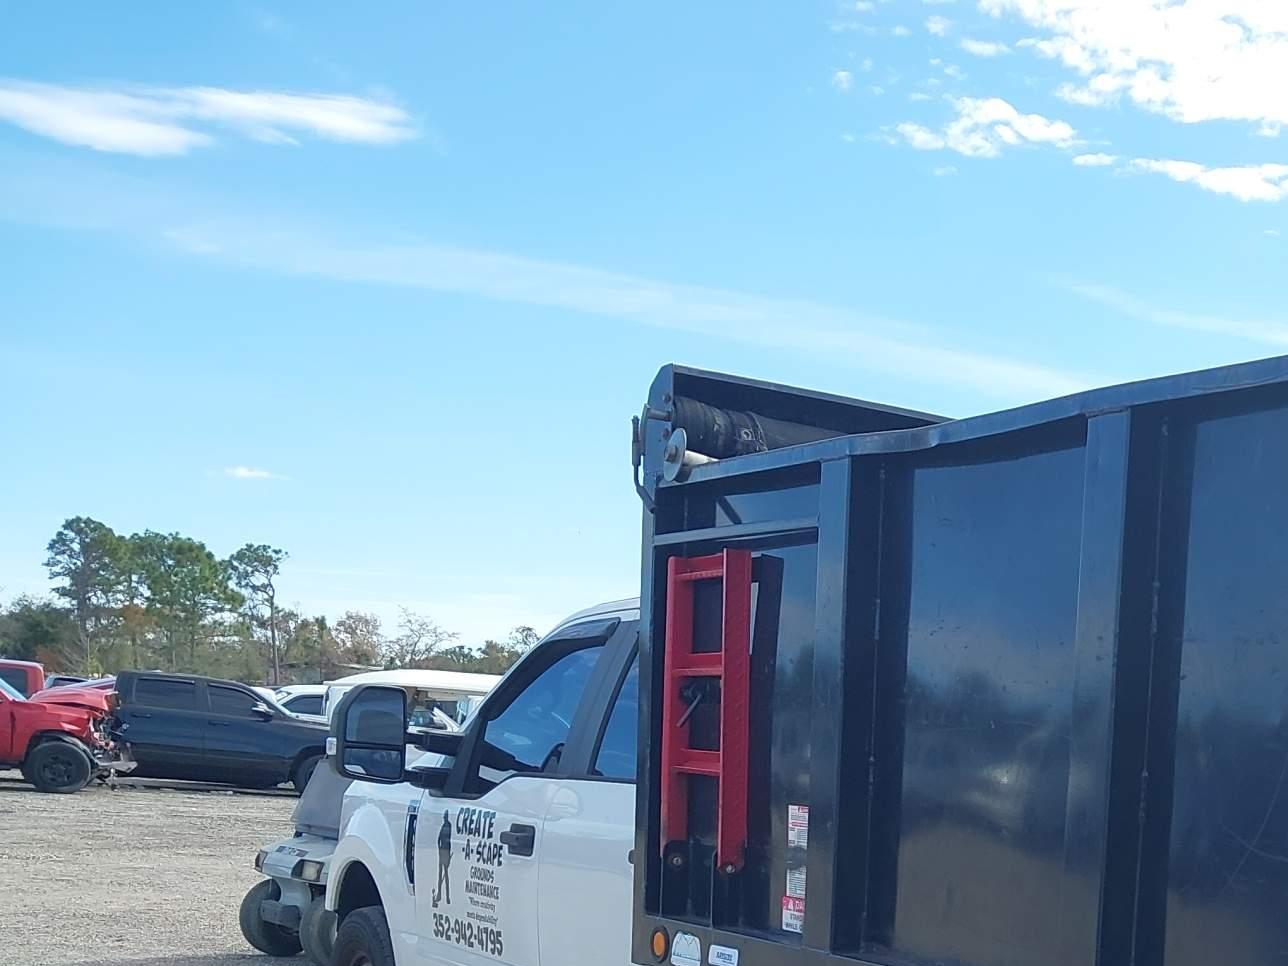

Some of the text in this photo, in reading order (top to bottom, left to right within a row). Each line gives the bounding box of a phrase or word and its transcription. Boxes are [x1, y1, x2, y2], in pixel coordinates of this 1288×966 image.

[456, 807, 497, 839] CREATE
[476, 840, 503, 867] SCAPE
[470, 866, 494, 884] GROUNDS
[465, 880, 499, 900] MAINTENANCE
[432, 912, 504, 957] 352-942-4795
